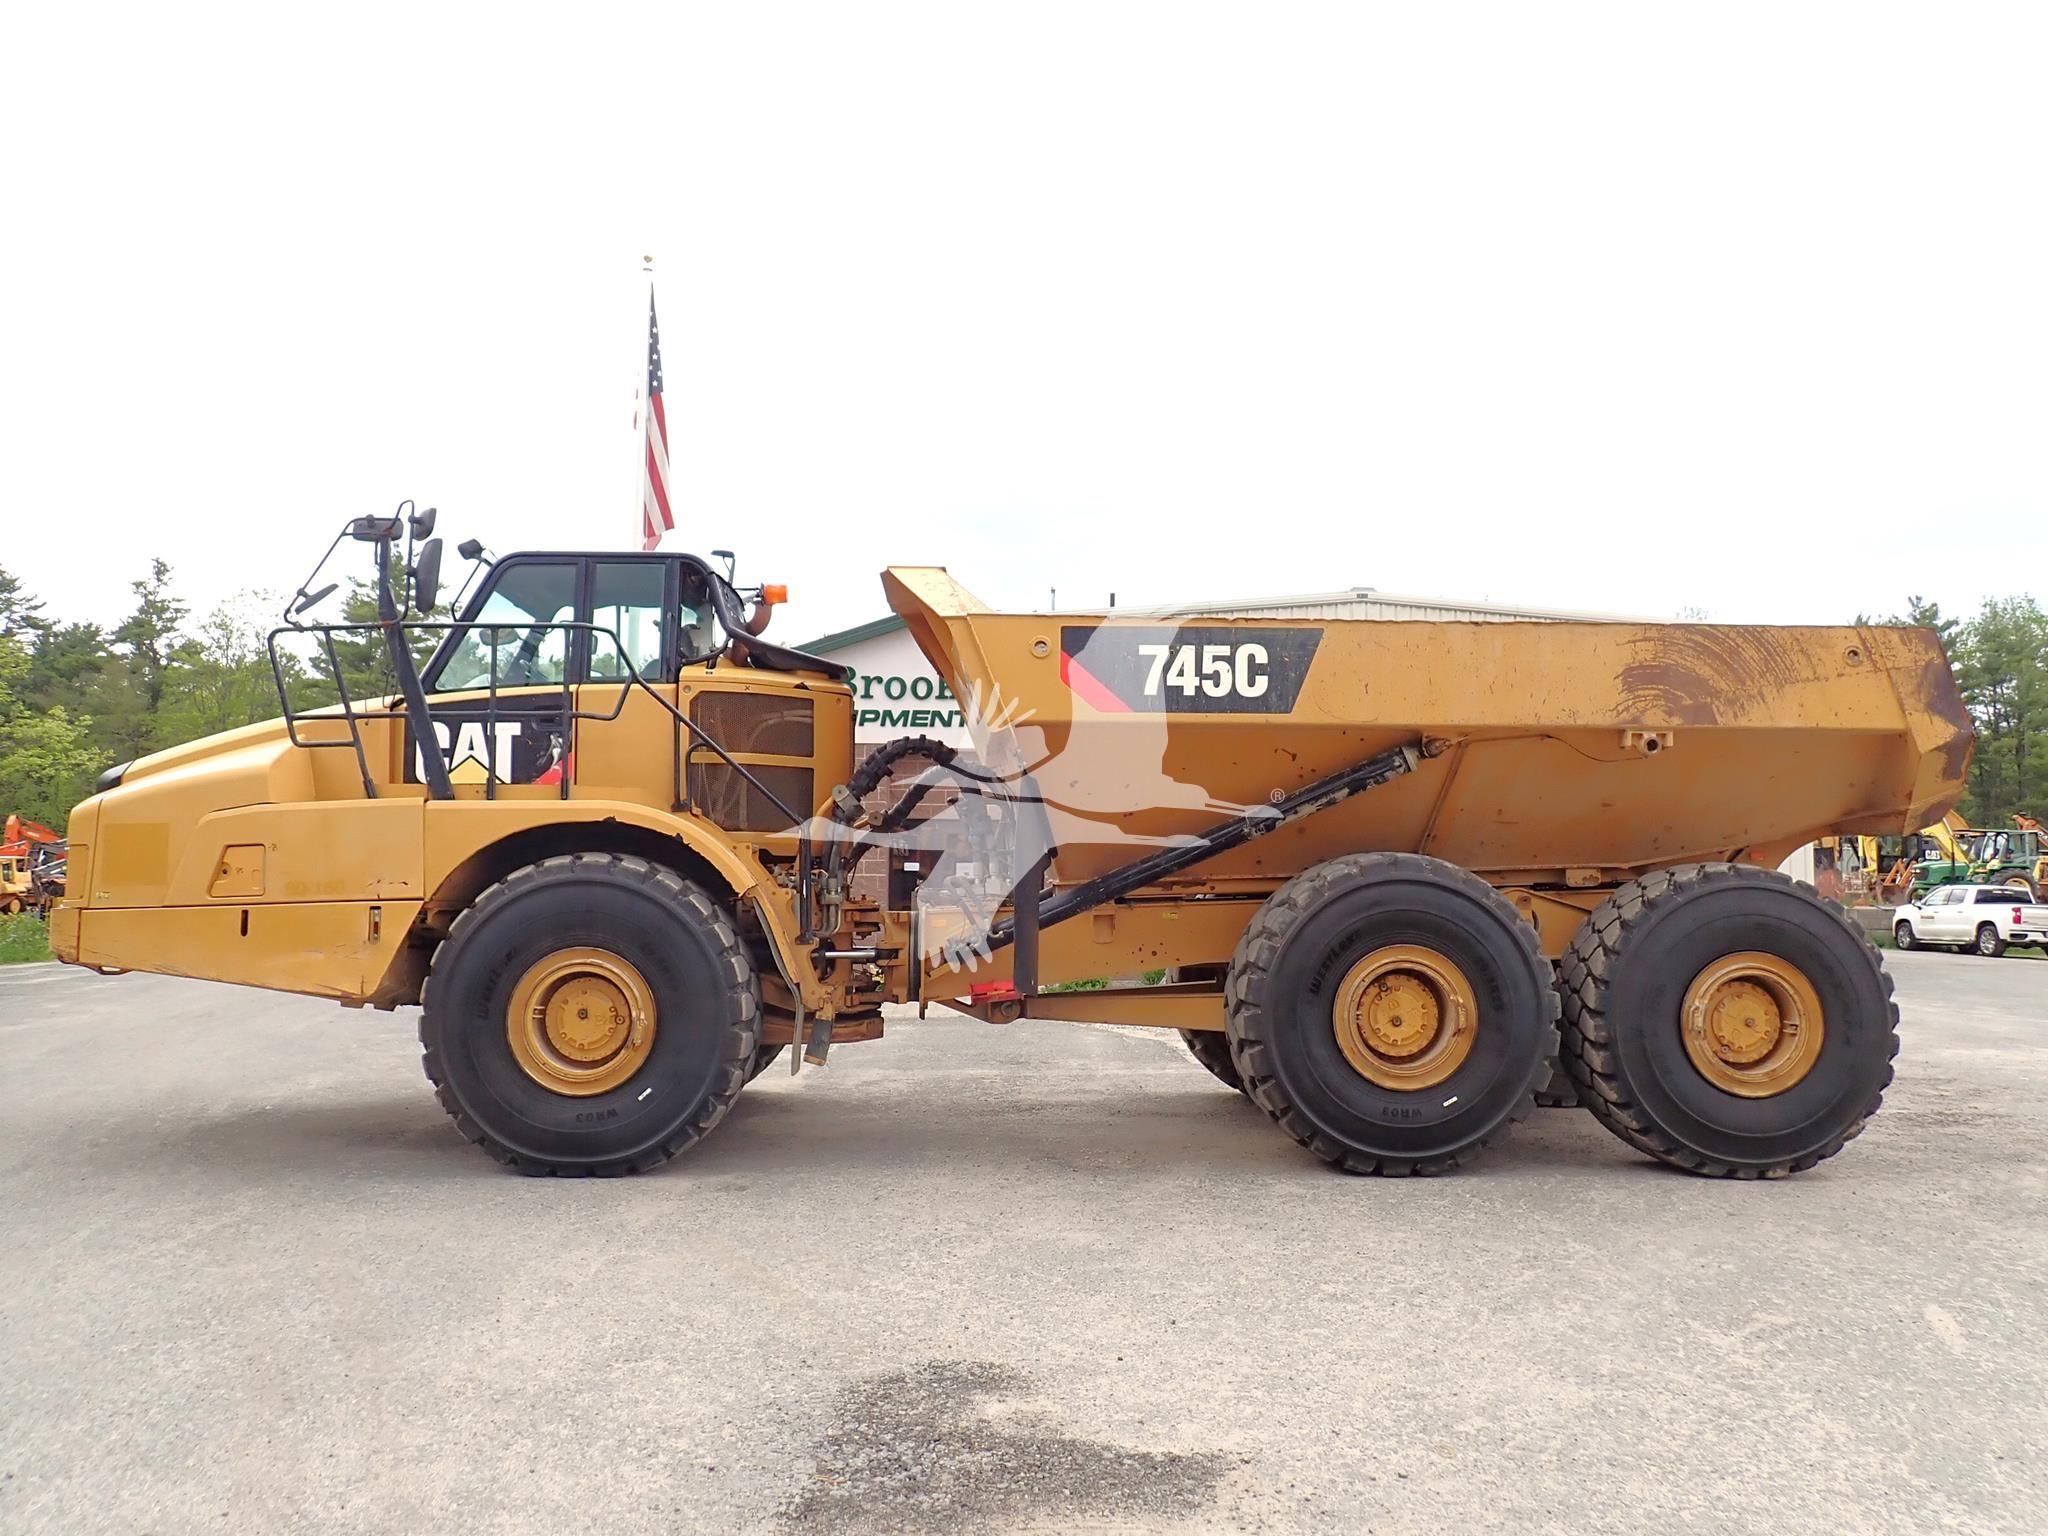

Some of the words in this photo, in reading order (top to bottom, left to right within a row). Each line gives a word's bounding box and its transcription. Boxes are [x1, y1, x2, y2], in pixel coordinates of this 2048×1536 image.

[1138, 643, 1269, 698] 745C
[854, 709, 966, 727] PMENT
[415, 721, 521, 784] CAT
[1925, 850, 1941, 860] CAT
